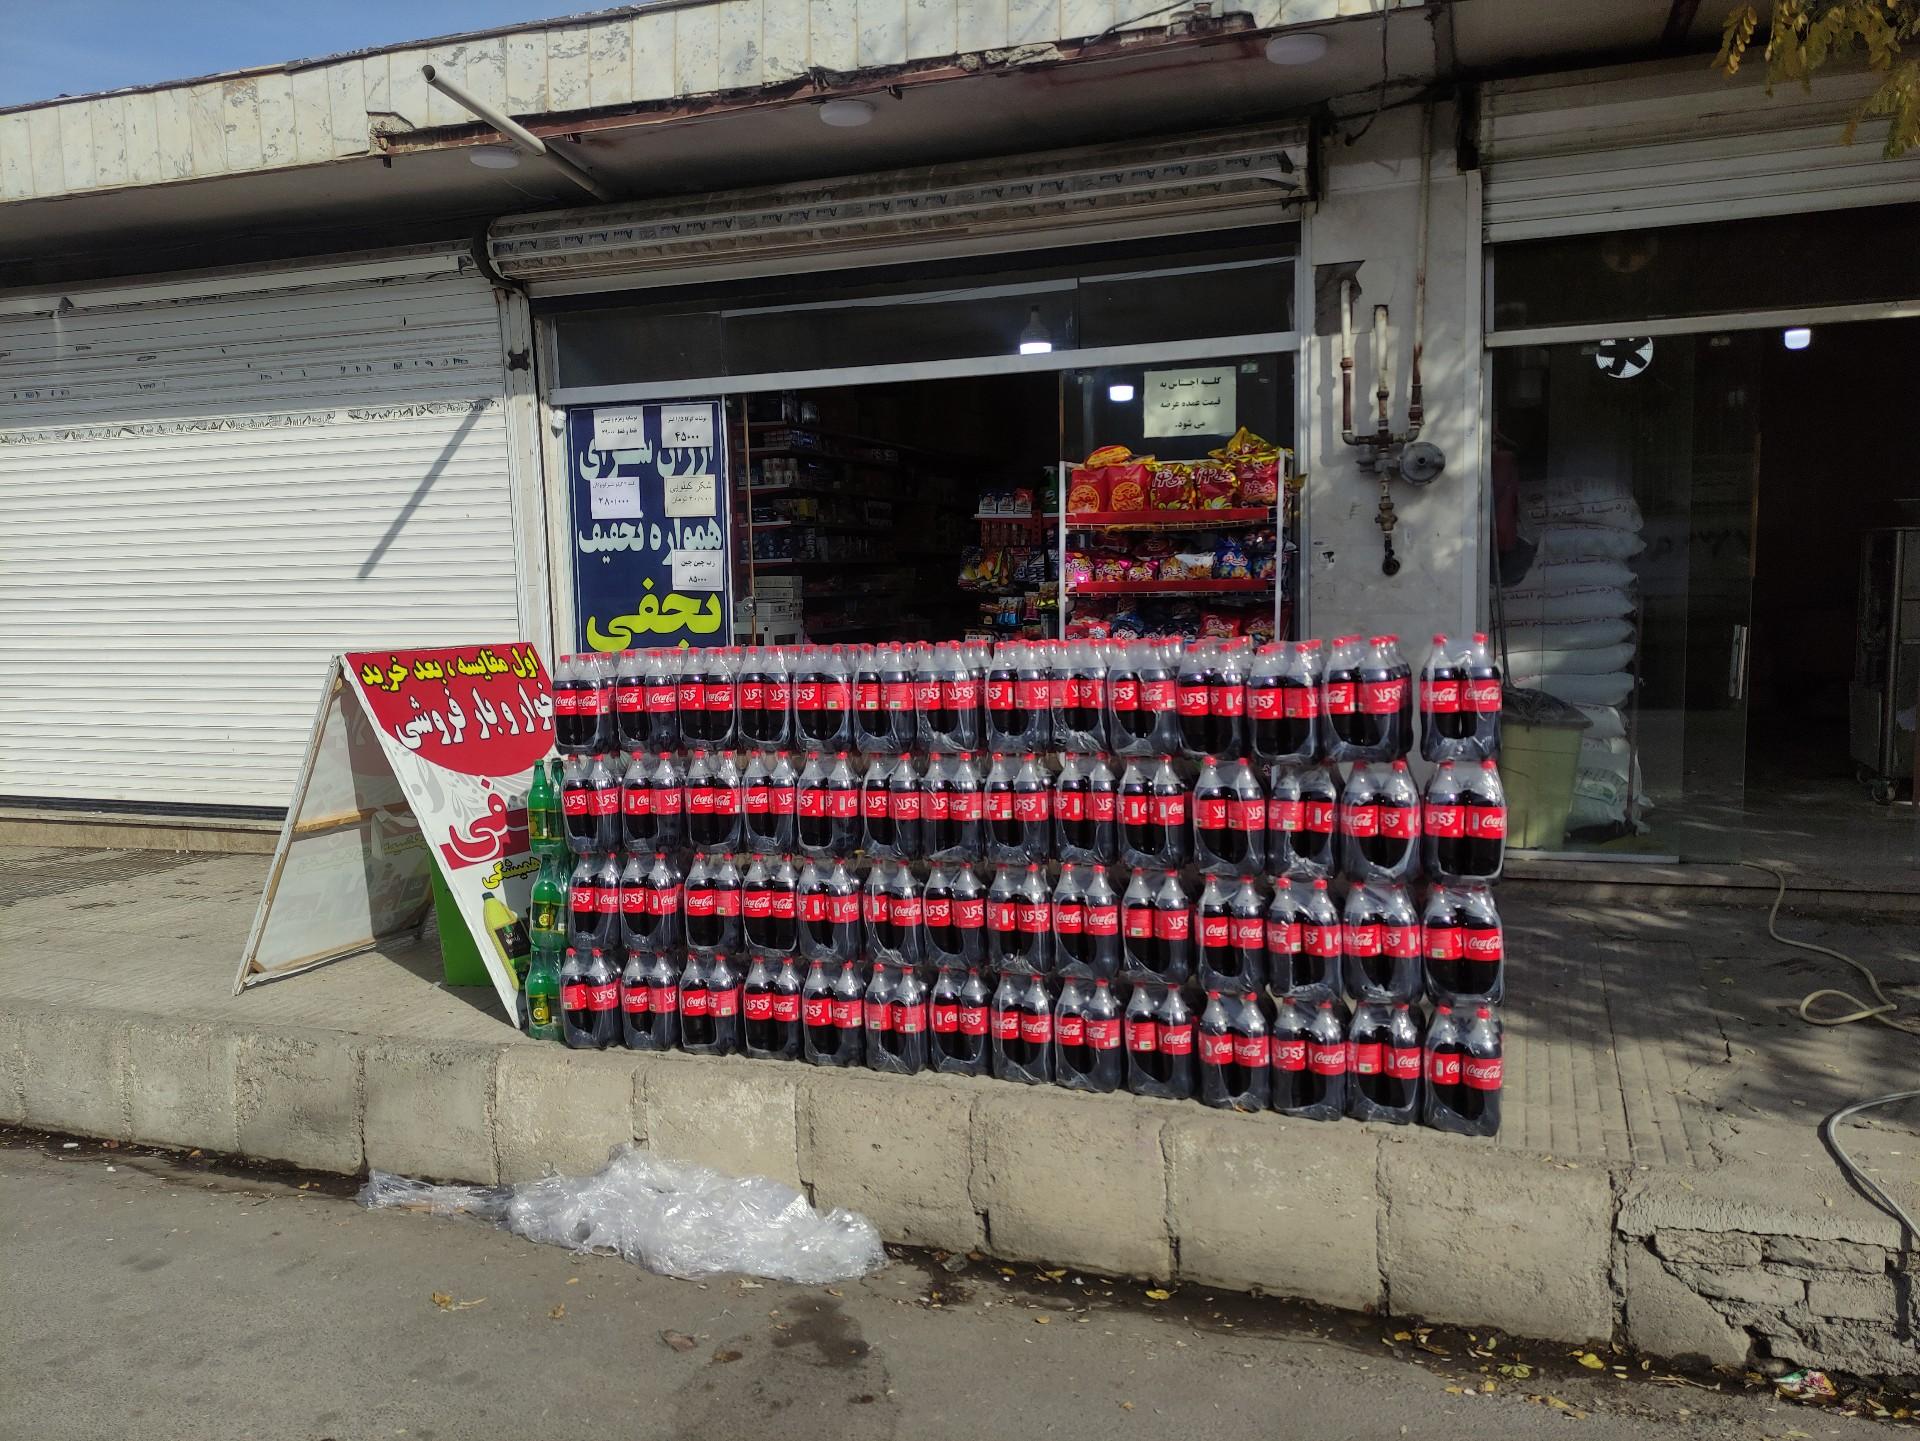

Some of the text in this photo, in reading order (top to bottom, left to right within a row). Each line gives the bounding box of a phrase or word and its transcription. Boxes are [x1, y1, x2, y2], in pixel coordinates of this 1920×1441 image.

[675, 431, 699, 442] ۴۵۰۰۰
[586, 577, 722, 653] نجفی
[361, 656, 409, 692] خرید
[413, 659, 447, 685] بعد
[511, 645, 539, 678] اول
[395, 687, 467, 750] فروشی
[471, 687, 504, 740] بار
